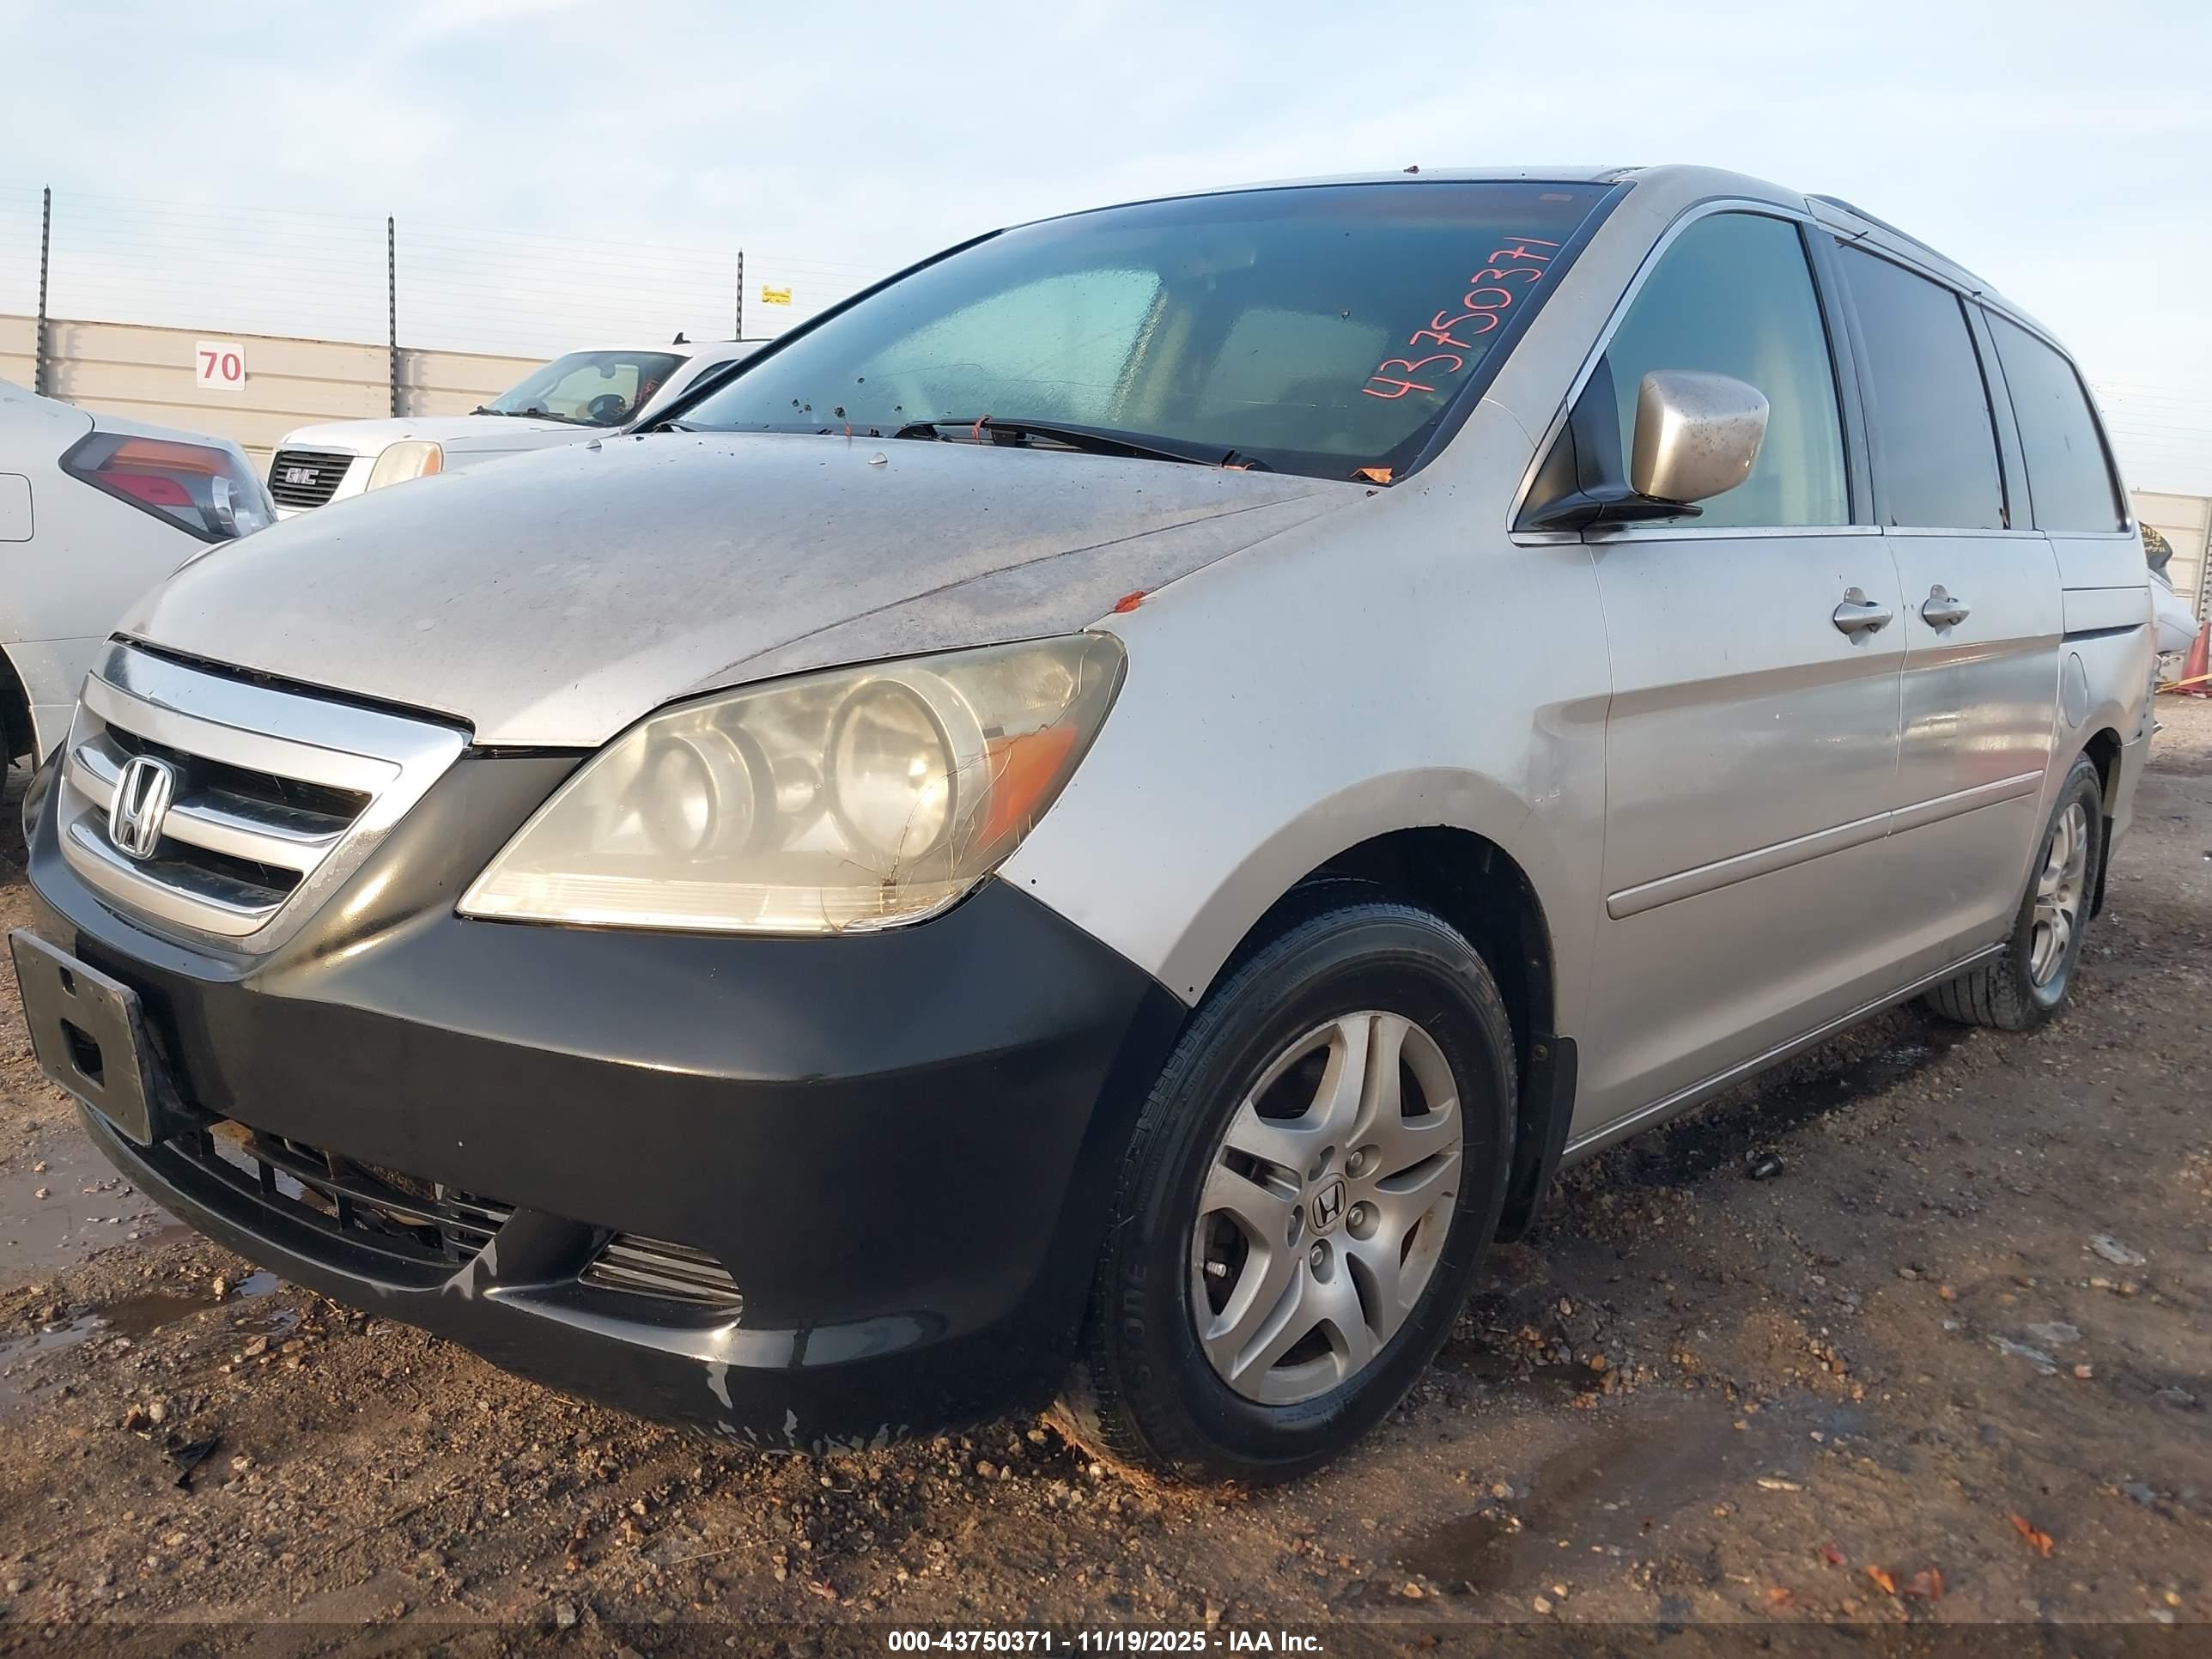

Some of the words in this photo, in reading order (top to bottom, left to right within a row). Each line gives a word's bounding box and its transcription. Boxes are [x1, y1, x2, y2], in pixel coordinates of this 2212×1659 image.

[1363, 237, 1560, 399] 43750371
[199, 351, 241, 380] 70
[286, 467, 319, 485] GMC
